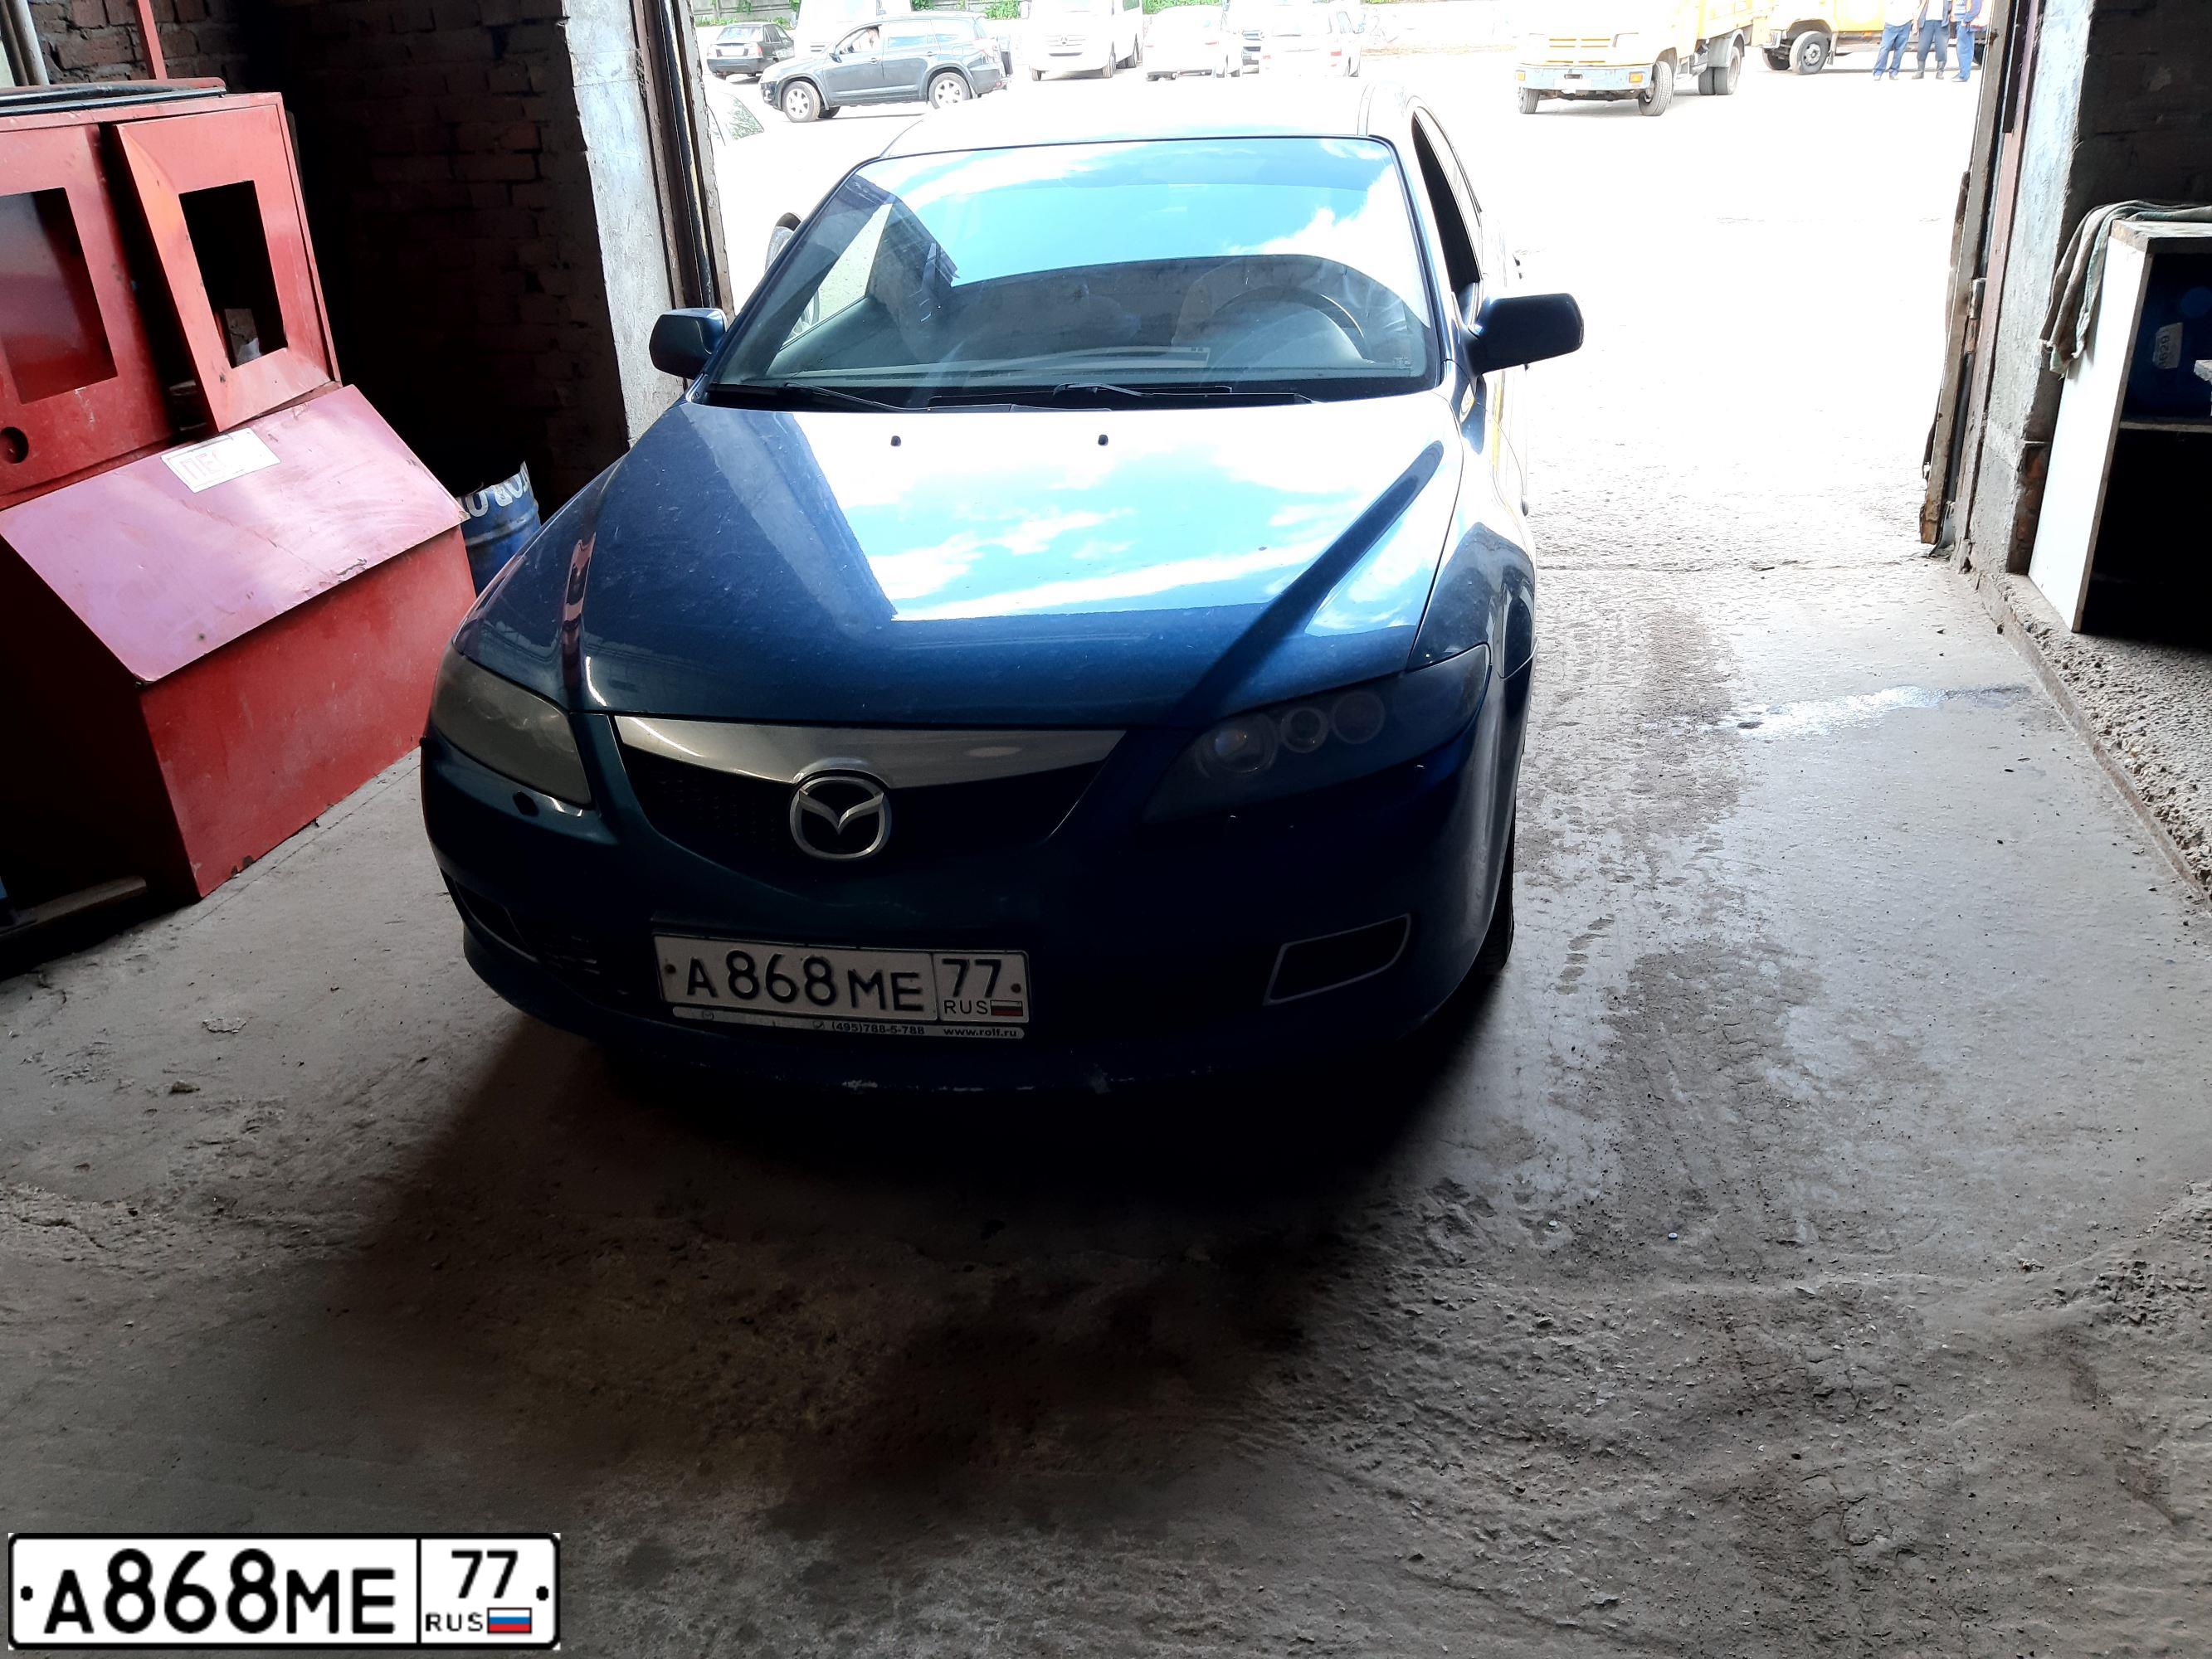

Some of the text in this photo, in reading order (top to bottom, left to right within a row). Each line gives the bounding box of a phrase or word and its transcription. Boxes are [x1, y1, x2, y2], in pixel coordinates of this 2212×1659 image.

[942, 958, 1002, 997] 77
[944, 1000, 988, 1014] RUS
[943, 1027, 1017, 1038] www.rolf.ru
